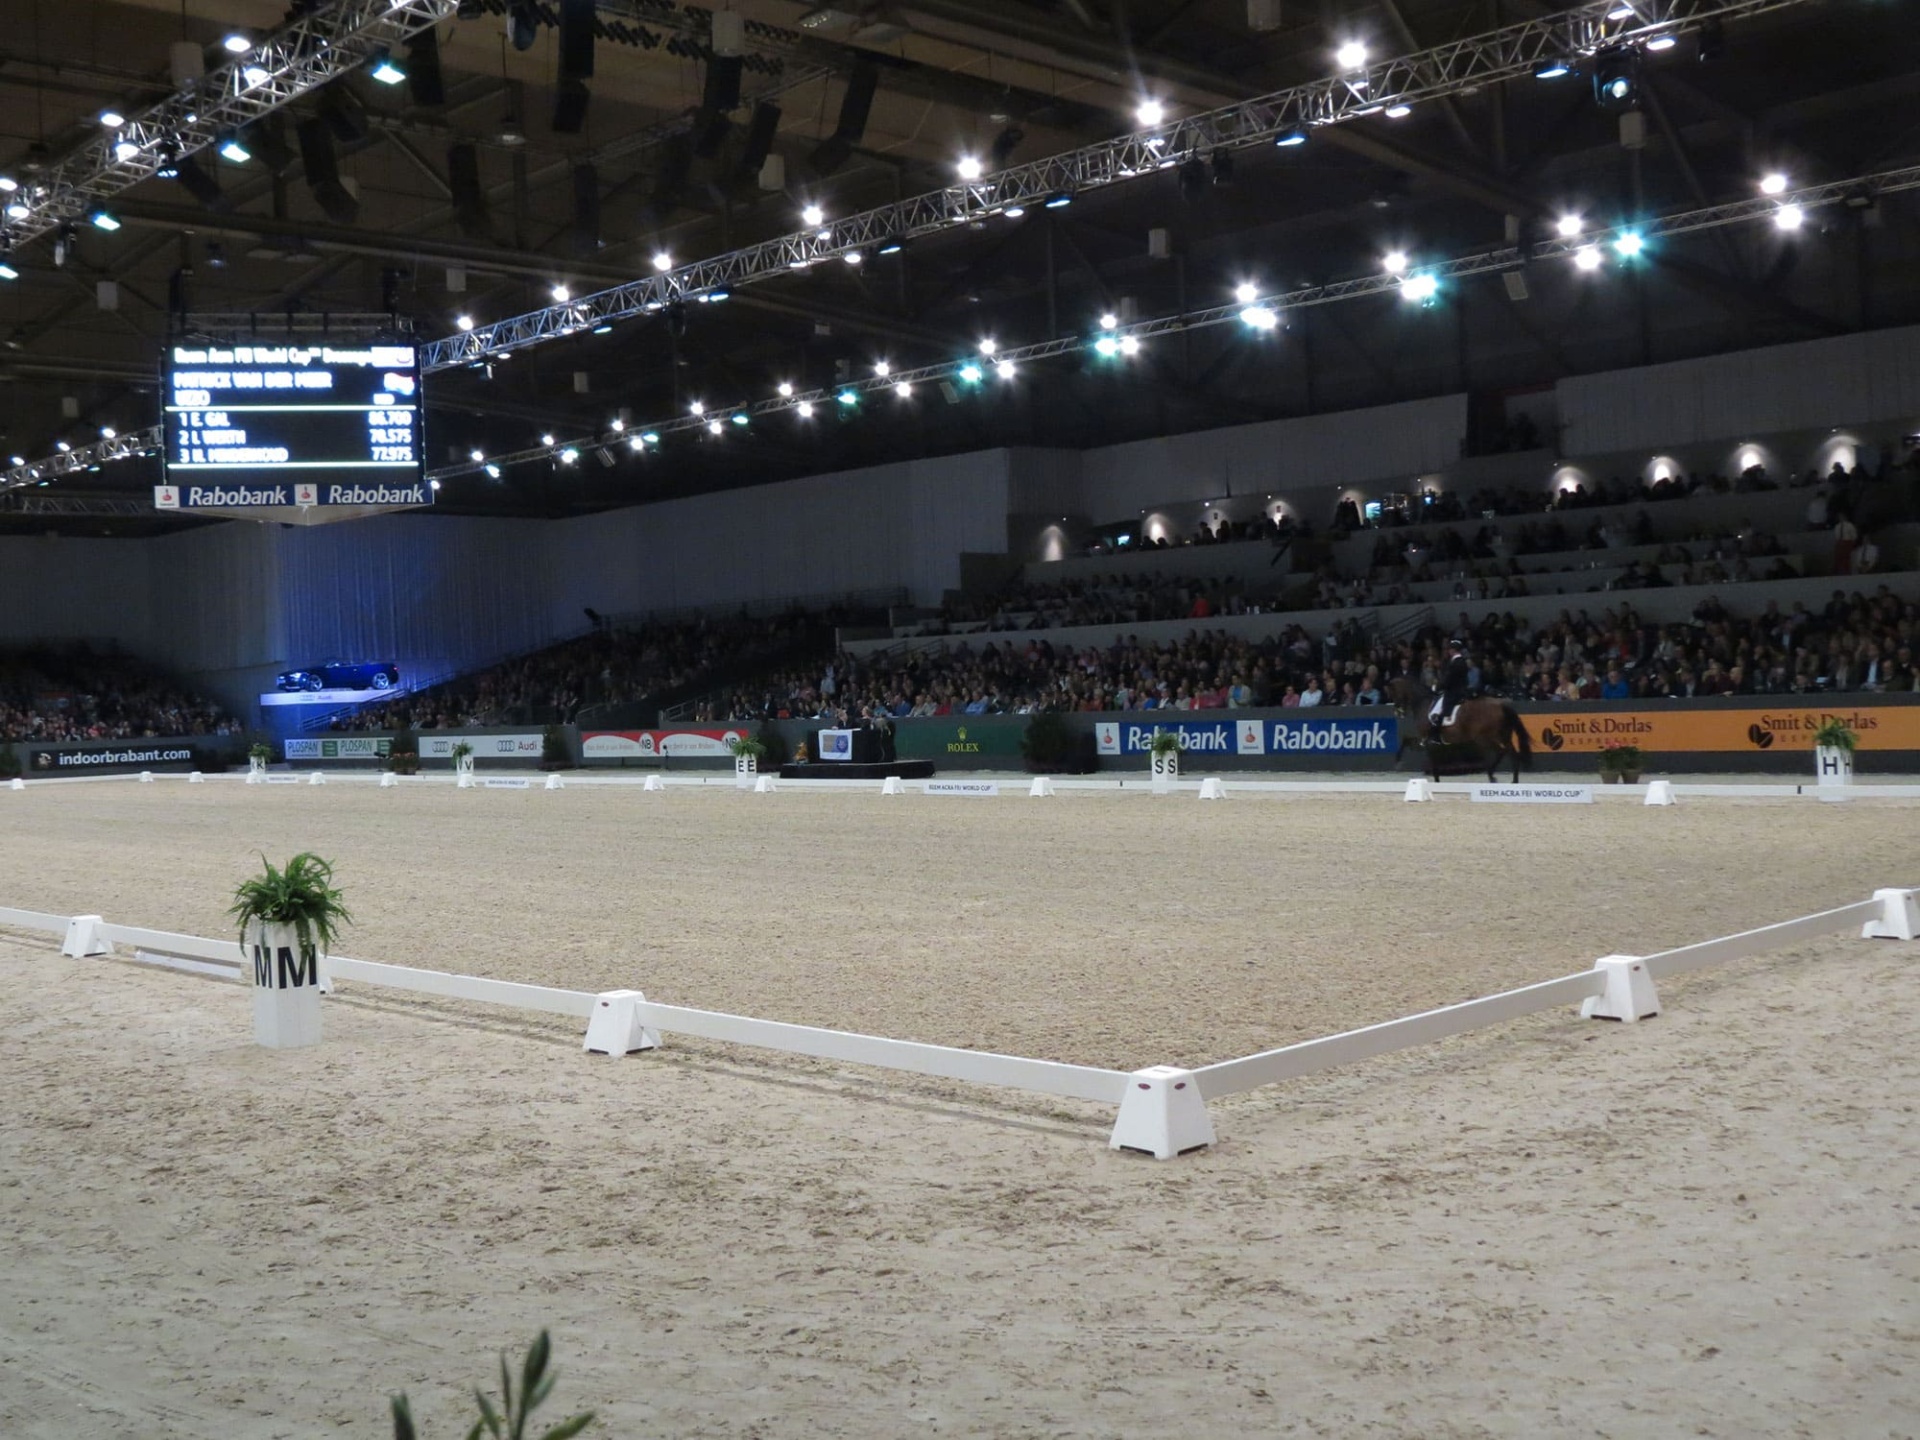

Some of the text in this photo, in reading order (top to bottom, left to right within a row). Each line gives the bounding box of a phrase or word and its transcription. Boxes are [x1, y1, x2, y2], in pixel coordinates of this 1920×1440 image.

[179, 412, 188, 427] 1
[179, 430, 189, 445] 2
[180, 448, 190, 463] 3
[189, 485, 286, 506] Rabobank
[329, 484, 424, 504] Rabobank
[1553, 716, 1652, 734] Smit & Dorlas
[1761, 714, 1799, 730] Smit
[1804, 714, 1818, 730] &
[1273, 722, 1387, 750] Rabobank
[518, 741, 537, 751] Audi
[947, 743, 979, 752] ROLEX
[59, 749, 190, 765] indoorbrabant.com
[465, 761, 472, 770] V
[738, 760, 744, 772] E
[747, 760, 755, 772] E
[1155, 759, 1164, 774] S
[1167, 759, 1176, 774] S
[1823, 757, 1838, 775] H
[1480, 785, 1499, 796] REEM
[1500, 785, 1519, 797] ACRA
[1521, 785, 1532, 797] FEI
[1534, 785, 1563, 798] WORLD
[254, 945, 273, 989] M
[277, 944, 317, 989] M
